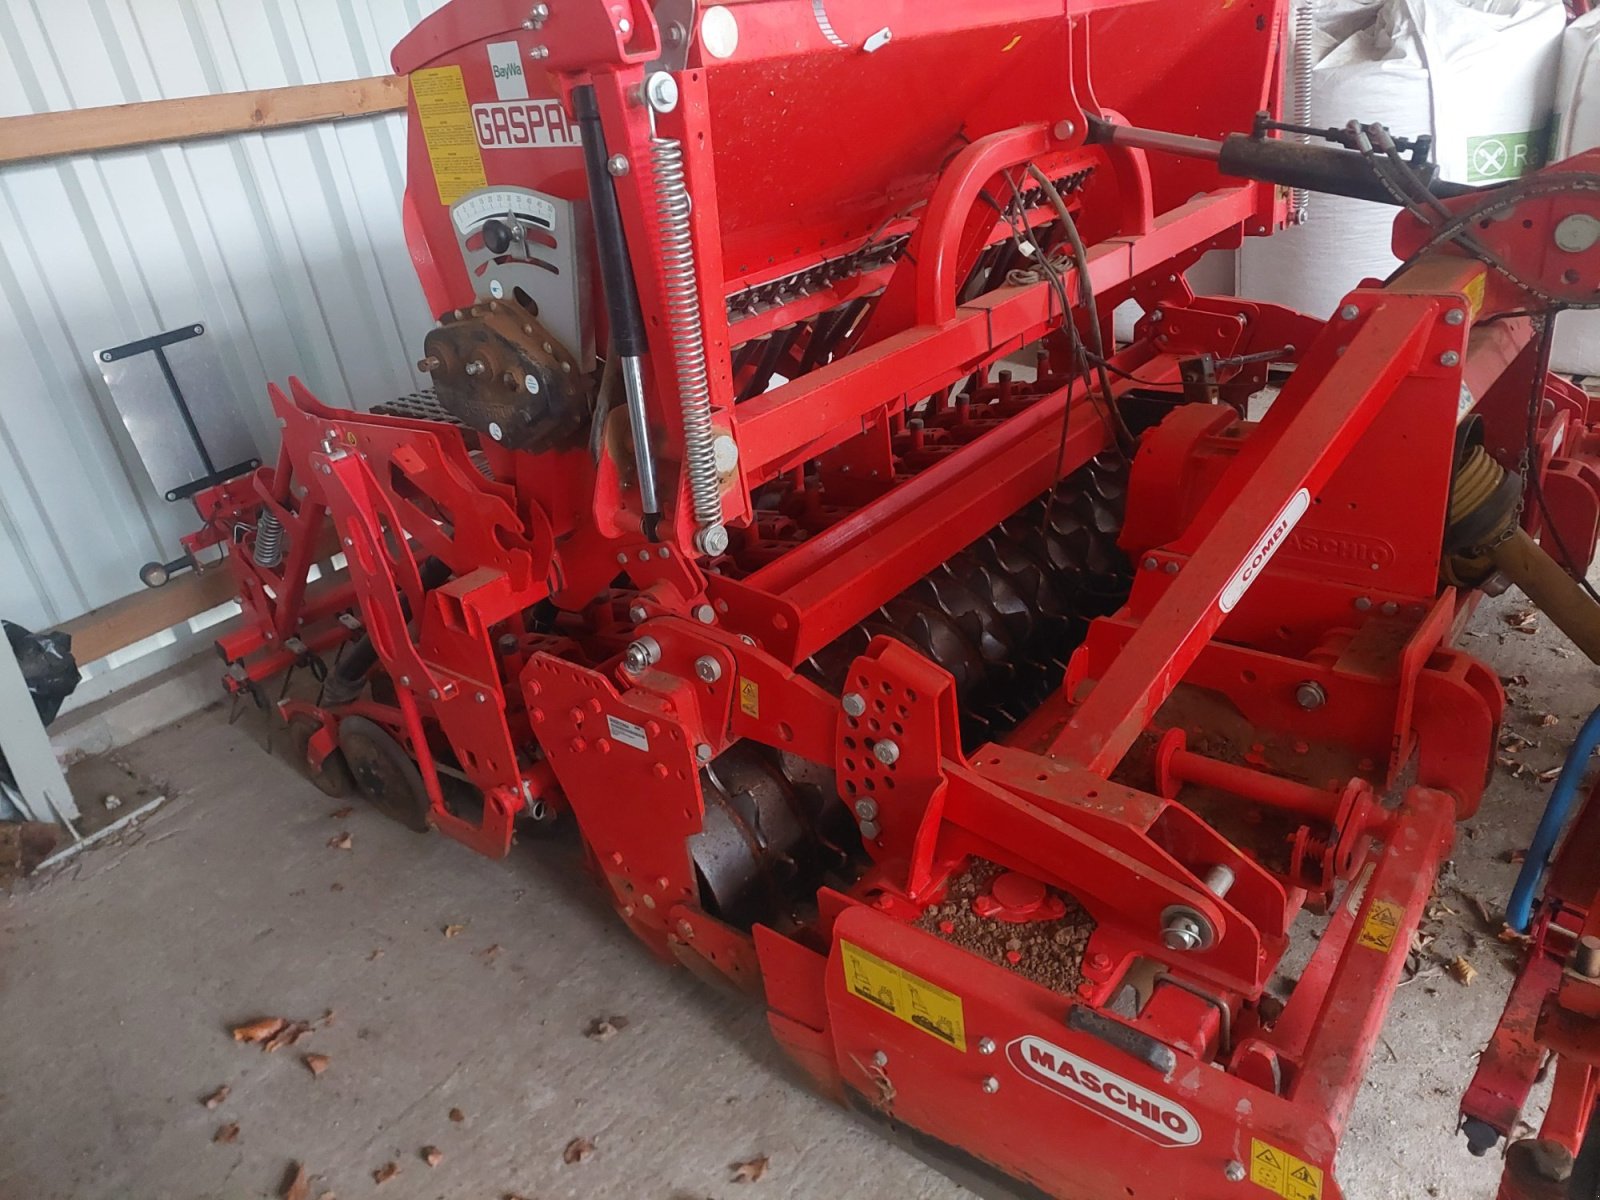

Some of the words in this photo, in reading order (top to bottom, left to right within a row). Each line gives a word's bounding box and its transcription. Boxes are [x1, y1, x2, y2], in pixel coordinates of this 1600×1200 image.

[493, 63, 522, 79] BayWa
[1241, 520, 1289, 582] COMBI
[1286, 533, 1389, 563] ASCHIO
[1029, 1044, 1188, 1135] MASCHIO
